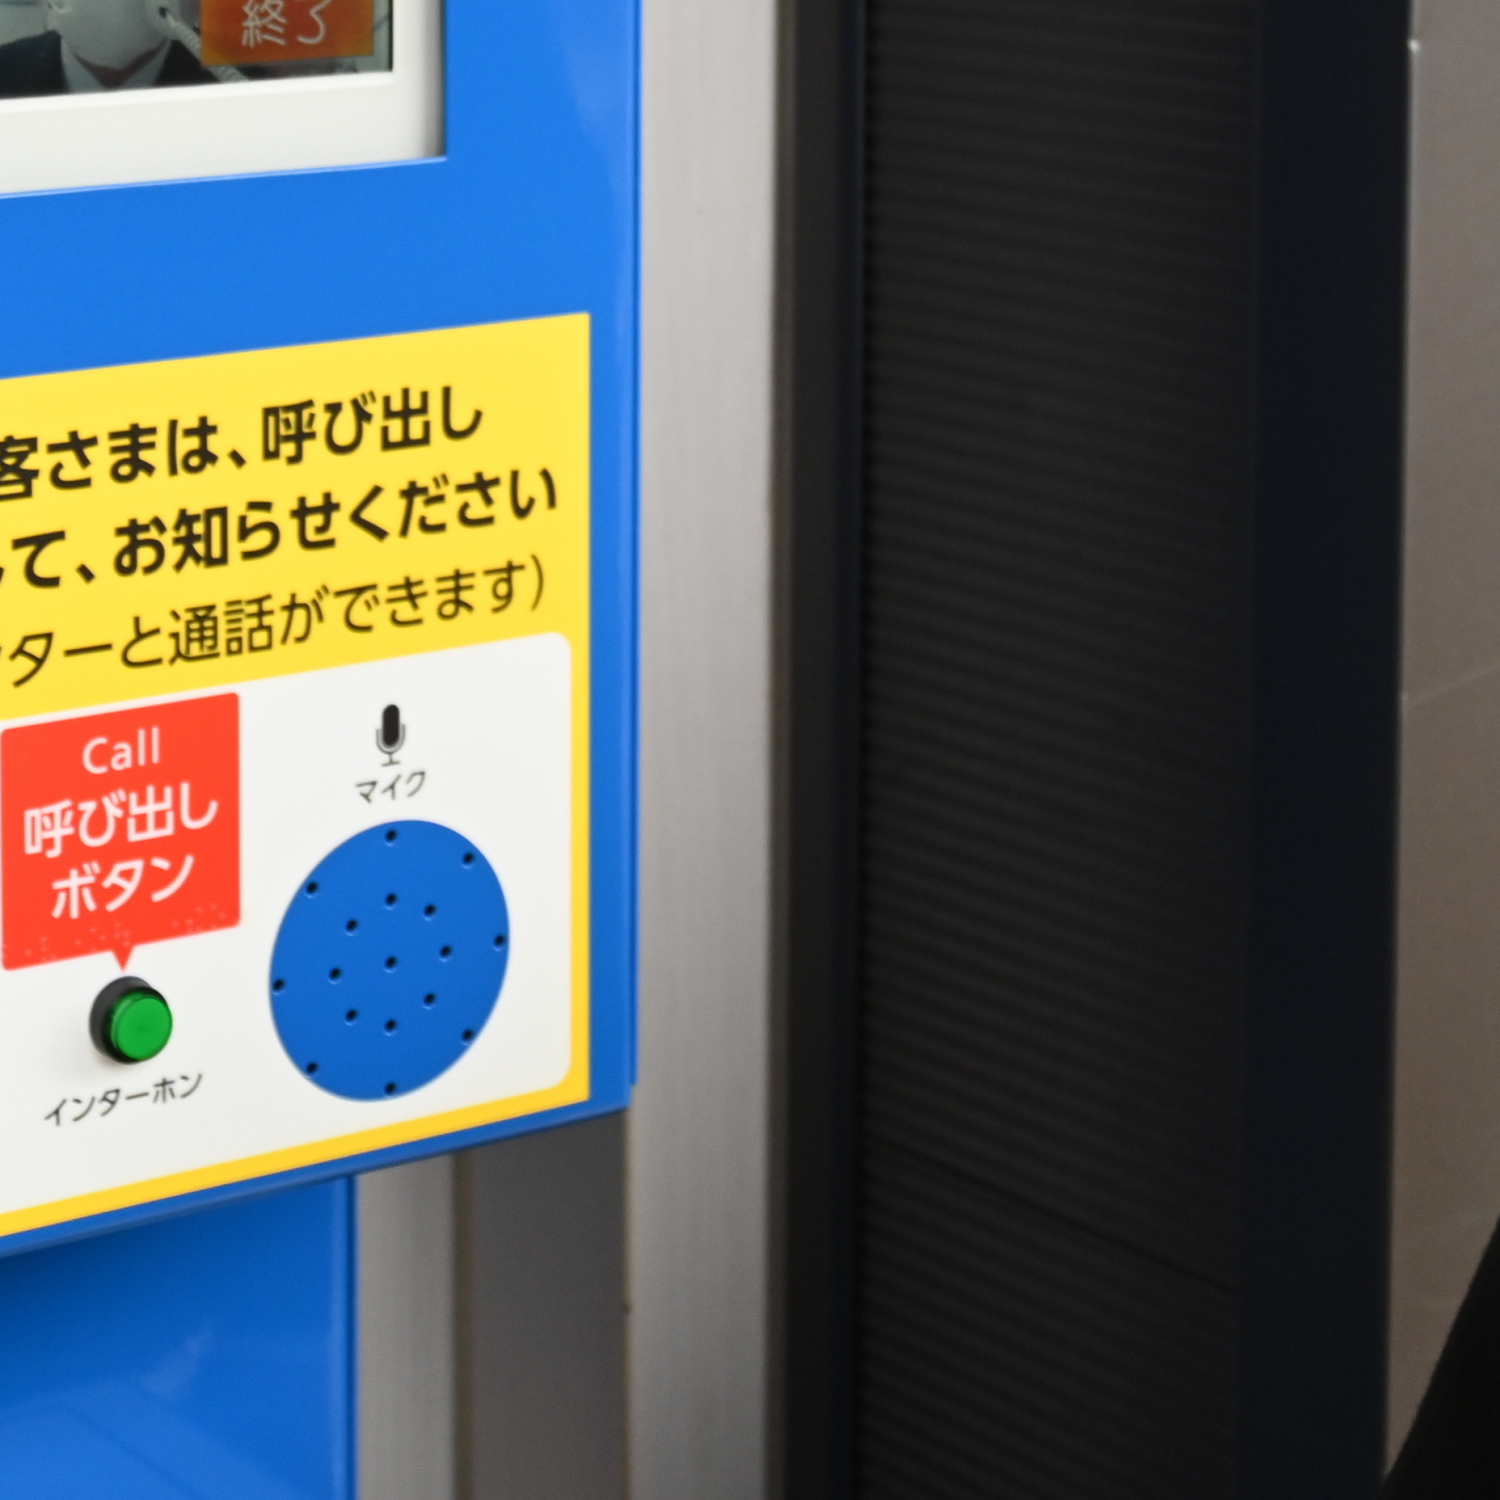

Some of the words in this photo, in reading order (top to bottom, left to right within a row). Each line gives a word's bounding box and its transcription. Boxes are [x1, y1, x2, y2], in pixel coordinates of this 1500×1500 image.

[82, 727, 159, 775] Call
[355, 768, 427, 804] マイク
[23, 781, 220, 859] 呼び出し
[51, 854, 196, 923] ボタン
[43, 1072, 203, 1127] インターホン
